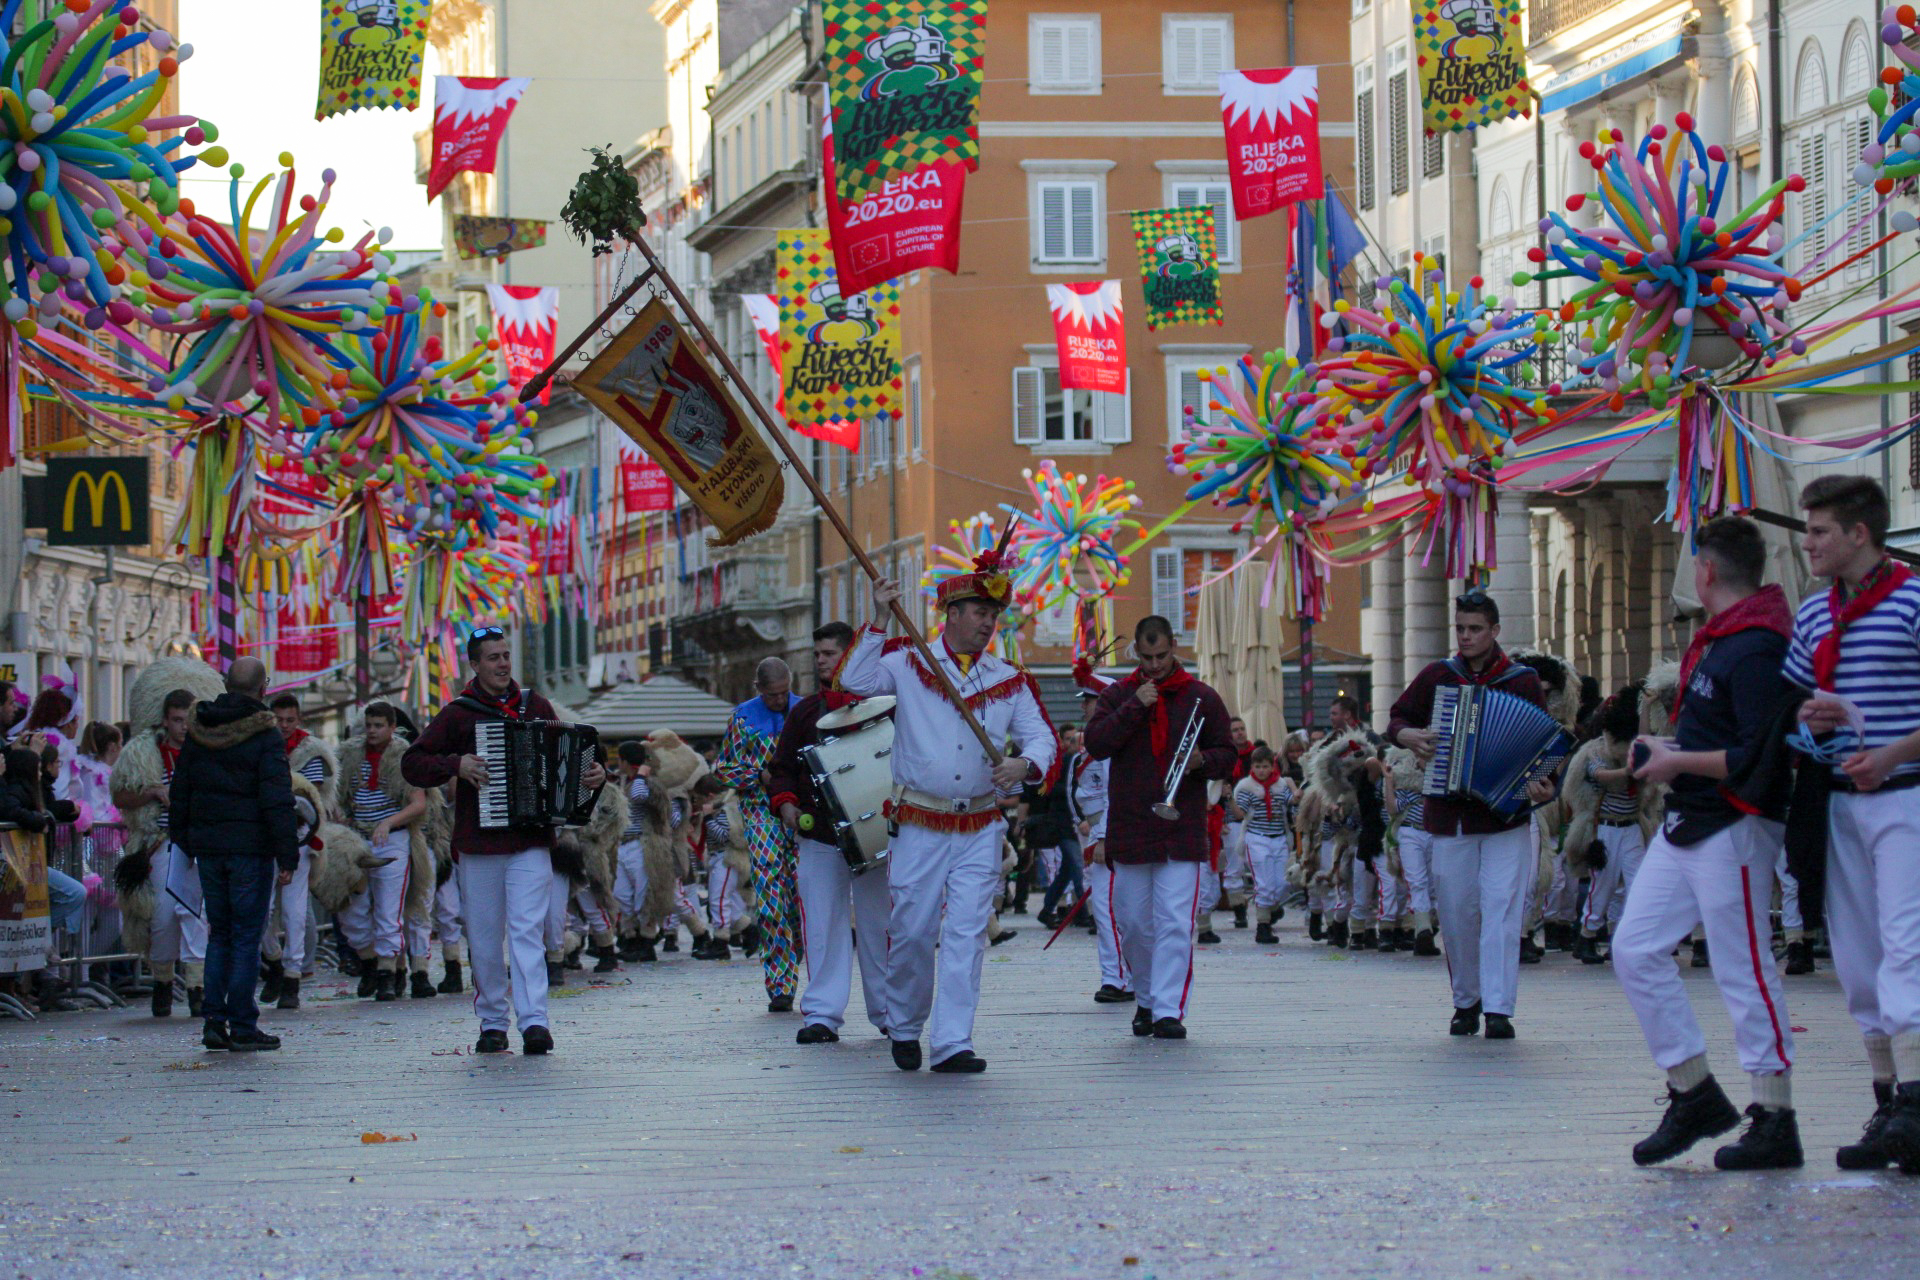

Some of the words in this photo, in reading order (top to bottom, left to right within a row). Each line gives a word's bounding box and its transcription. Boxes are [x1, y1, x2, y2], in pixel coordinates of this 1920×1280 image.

[1241, 134, 1306, 159] RIJEKA
[845, 193, 943, 229] 2020.eu
[895, 224, 944, 239] EUROPEAN
[896, 235, 930, 248] CAPITAL
[931, 233, 945, 241] OF
[896, 242, 936, 257] CULTURE
[644, 324, 673, 354] 1908
[1068, 335, 1118, 350] RIJEKA
[1468, 703, 1479, 734] RUTAR
